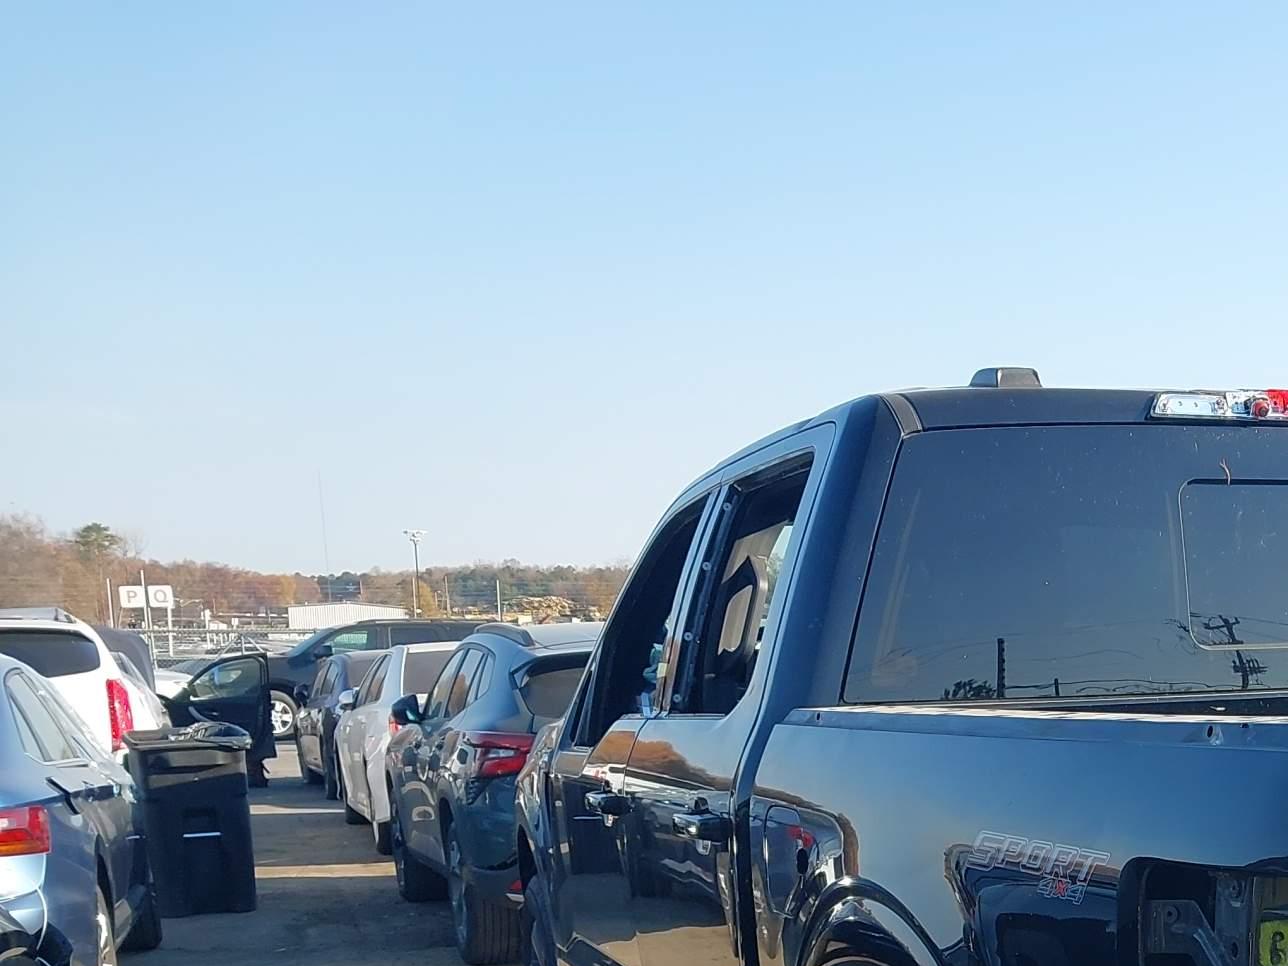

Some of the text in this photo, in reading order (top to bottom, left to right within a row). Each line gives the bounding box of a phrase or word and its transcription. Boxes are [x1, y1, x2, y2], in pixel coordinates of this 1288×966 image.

[126, 590, 137, 603] P
[154, 589, 169, 603] Q
[965, 830, 1111, 885] SPORT
